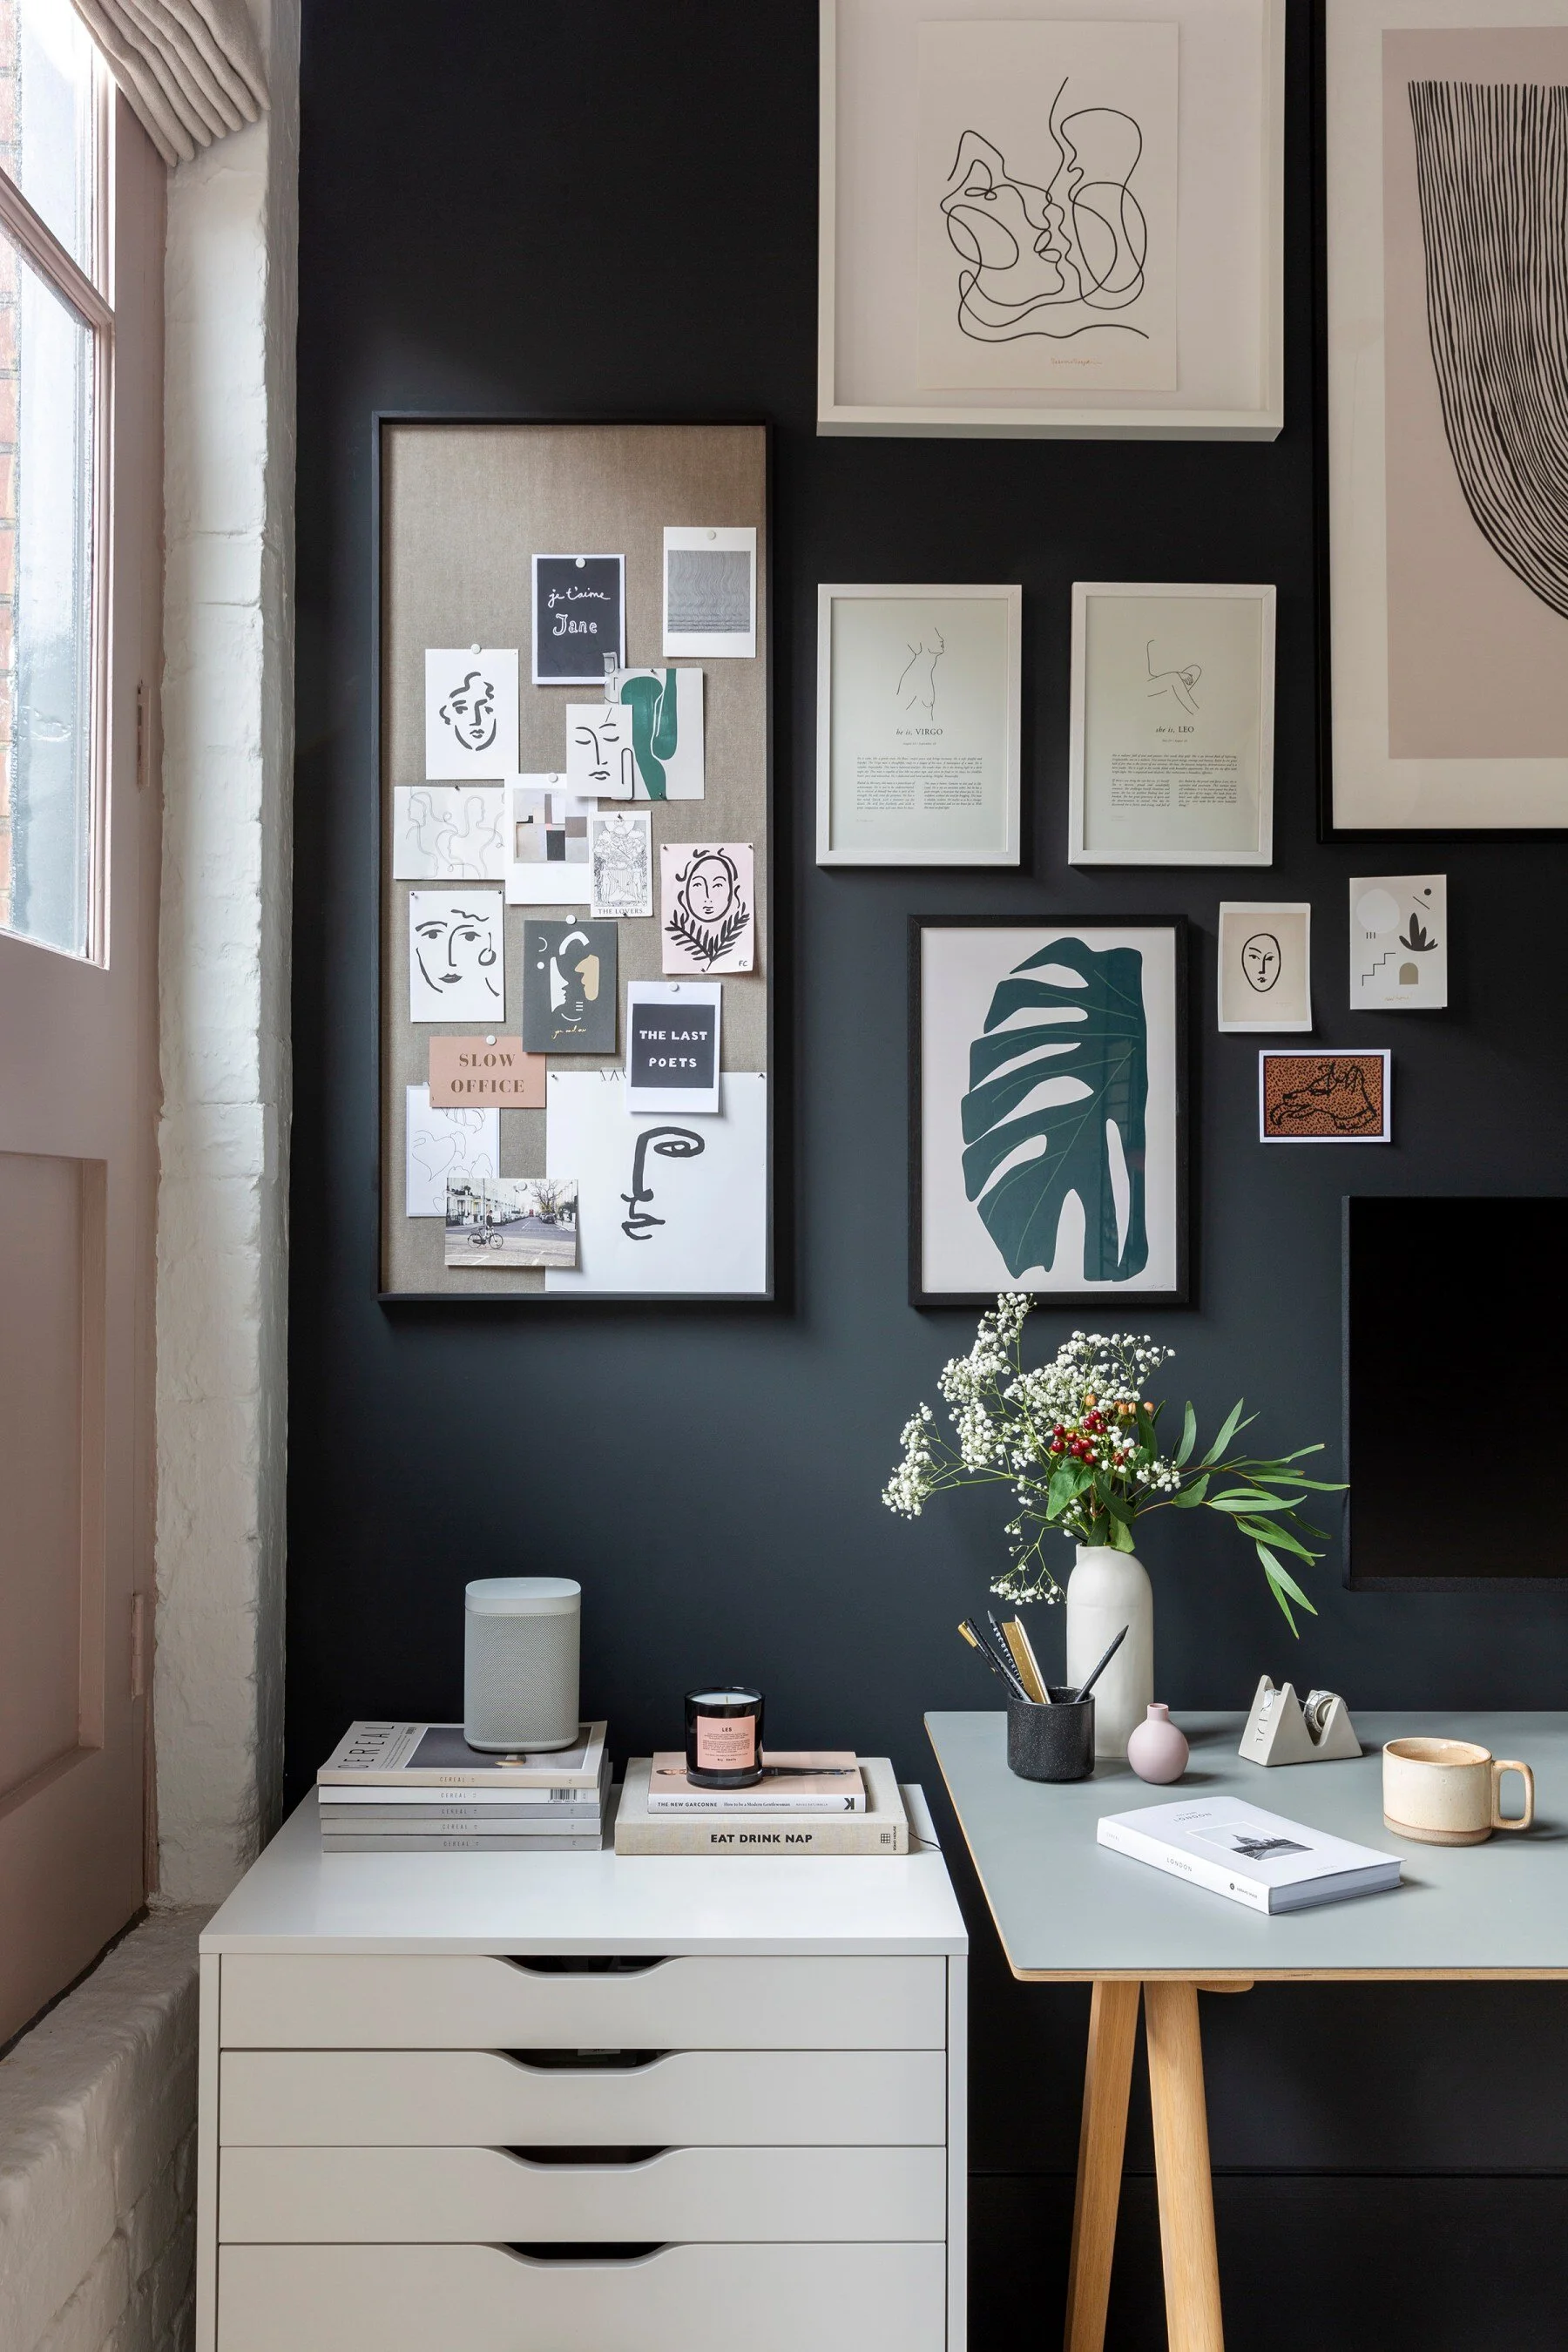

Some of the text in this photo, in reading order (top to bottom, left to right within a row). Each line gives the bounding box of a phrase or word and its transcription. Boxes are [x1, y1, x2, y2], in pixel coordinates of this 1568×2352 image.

[548, 589, 564, 608] je
[552, 613, 598, 636] Jane
[639, 1030, 708, 1041] THE LAST
[459, 1053, 515, 1067] SLOW
[648, 1057, 697, 1068] POETS
[450, 1079, 524, 1093] OFFICE
[337, 1726, 395, 1769] CEREAL
[710, 1834, 814, 1843] EAT DRINK NAP
[1166, 1857, 1193, 1872] LONDON
